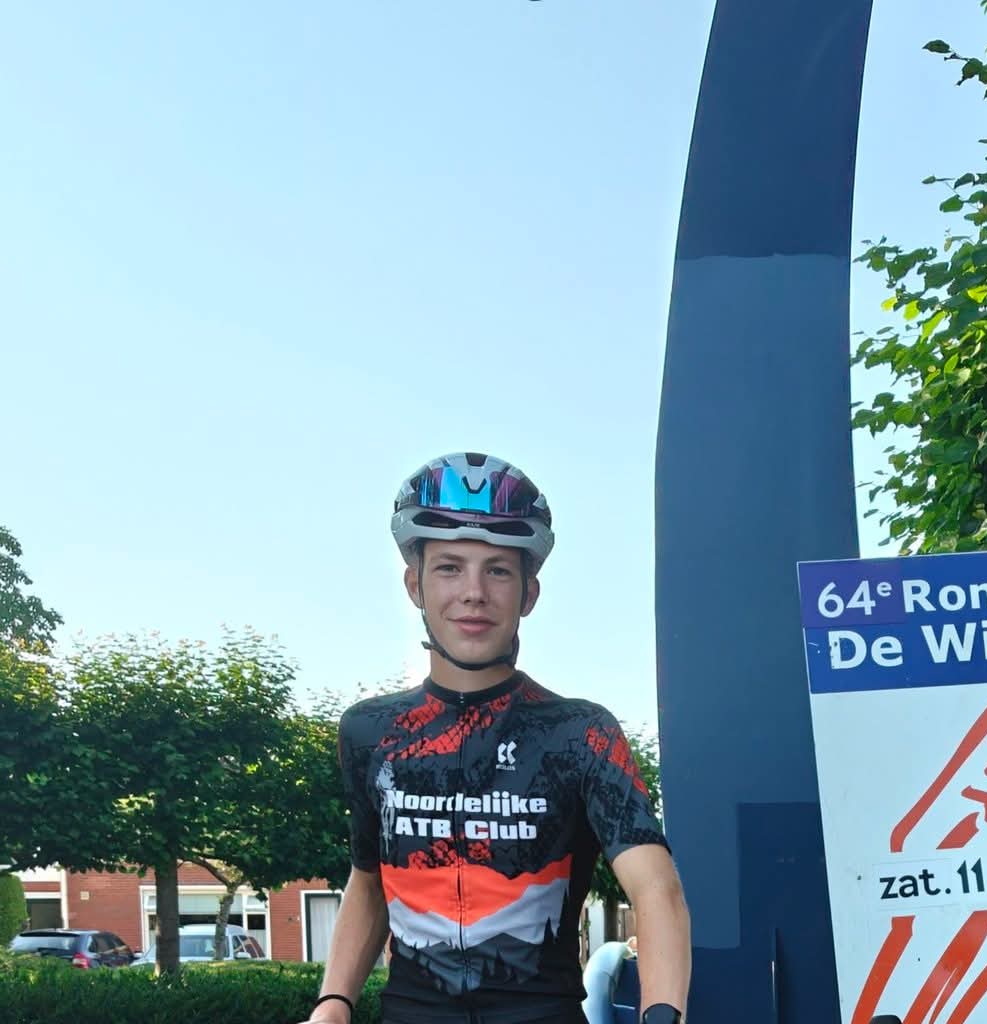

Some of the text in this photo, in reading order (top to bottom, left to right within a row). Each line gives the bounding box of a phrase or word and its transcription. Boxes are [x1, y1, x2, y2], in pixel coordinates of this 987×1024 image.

[828, 630, 903, 670] De
[384, 790, 548, 817] Noordelijke
[395, 816, 537, 840] ATB Club
[879, 868, 952, 900] zat.
[957, 857, 985, 894] 11
